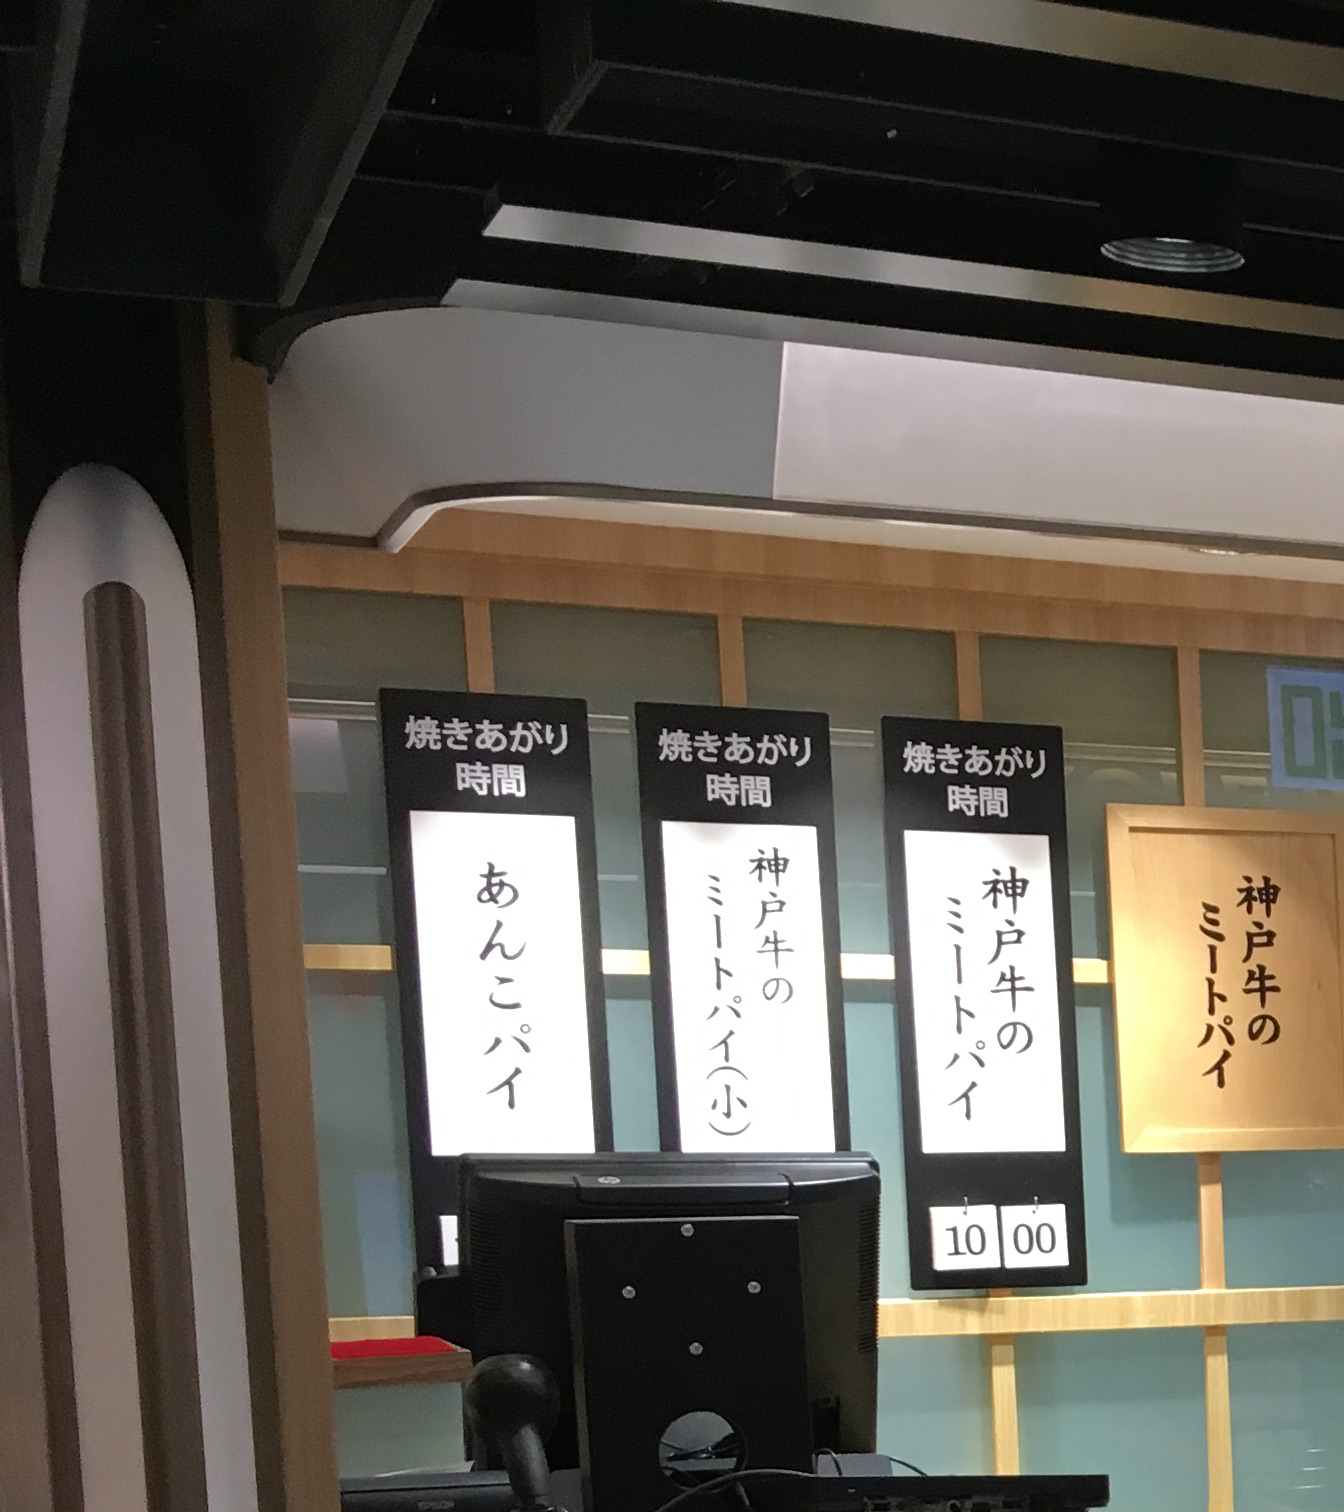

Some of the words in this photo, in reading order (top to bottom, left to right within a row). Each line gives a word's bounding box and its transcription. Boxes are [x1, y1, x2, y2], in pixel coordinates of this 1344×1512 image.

[404, 714, 568, 755] 焼きあがり
[658, 728, 812, 767] 焼きあがり
[455, 762, 526, 797] 時間
[903, 741, 1047, 779] 焼きあがり
[705, 773, 771, 808] 時間
[947, 785, 1008, 818] 時間
[748, 846, 795, 1005] 神戸牛の
[981, 865, 1036, 1057] 神戸牛の
[1237, 875, 1282, 1046] 神戸牛の
[475, 861, 532, 1112] あんこパイ
[1198, 902, 1238, 1090] ミートパイ
[944, 896, 986, 1122] ミートパイ
[944, 1225, 987, 1258] 10
[1012, 1222, 1056, 1255] 00
